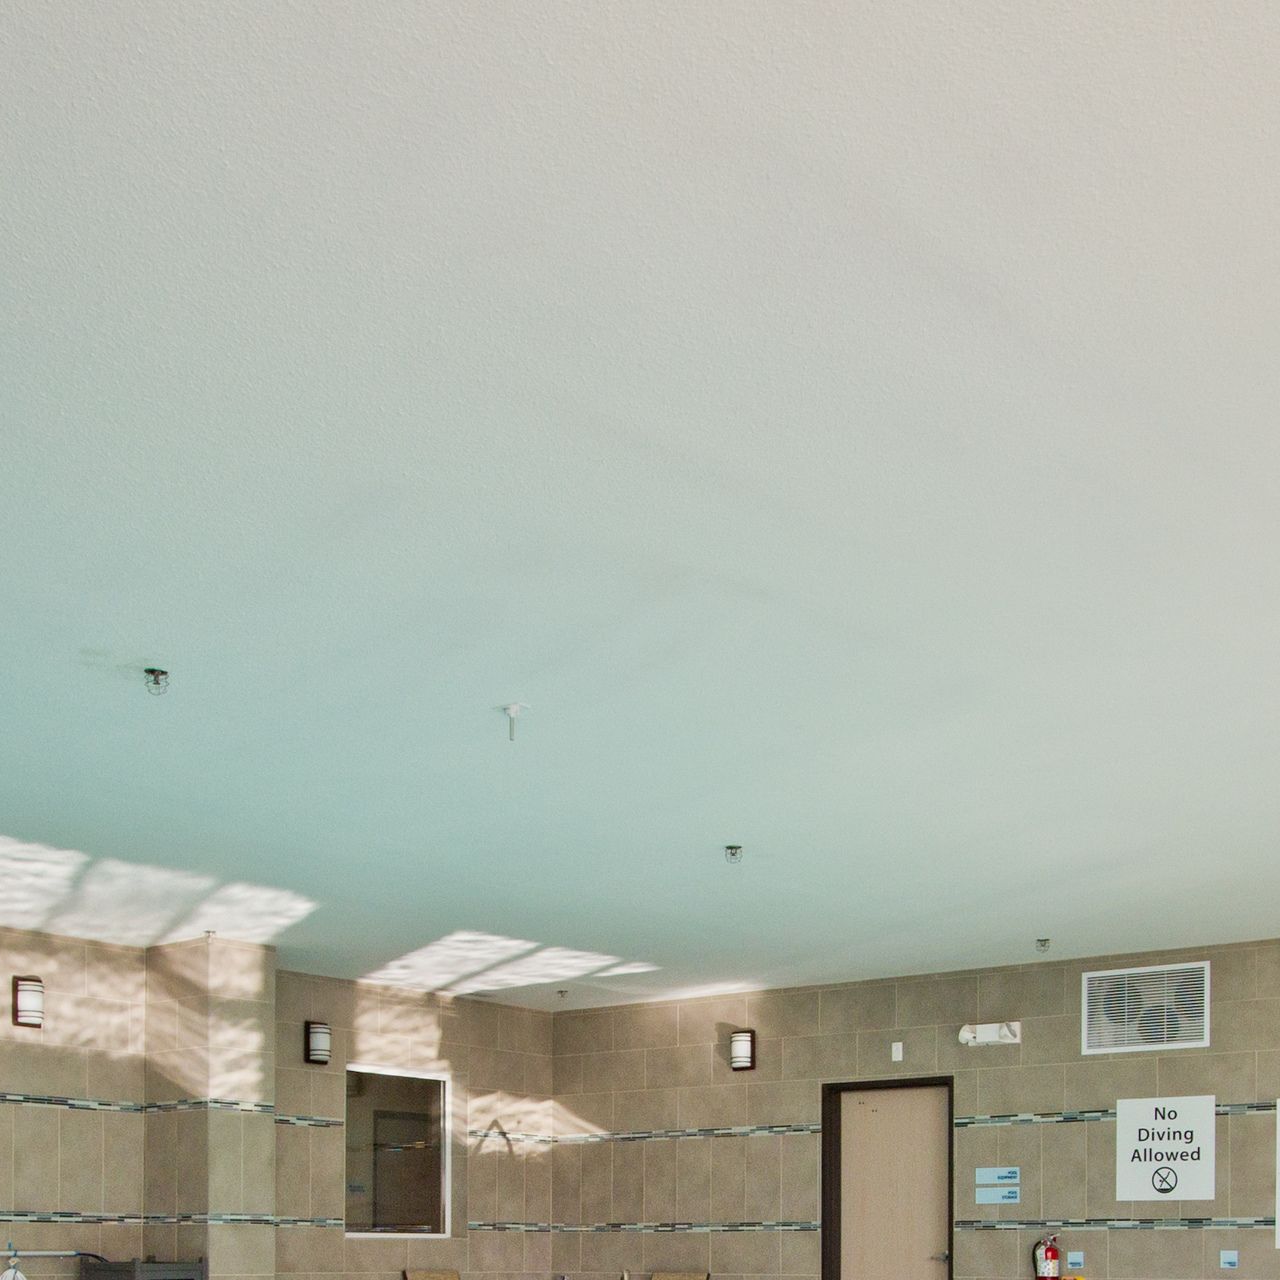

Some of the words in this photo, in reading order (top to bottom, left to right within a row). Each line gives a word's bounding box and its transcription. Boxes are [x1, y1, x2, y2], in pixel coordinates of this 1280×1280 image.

[1154, 1107, 1178, 1120] No
[1138, 1127, 1194, 1144] Diving
[1131, 1147, 1201, 1162] Allowed
